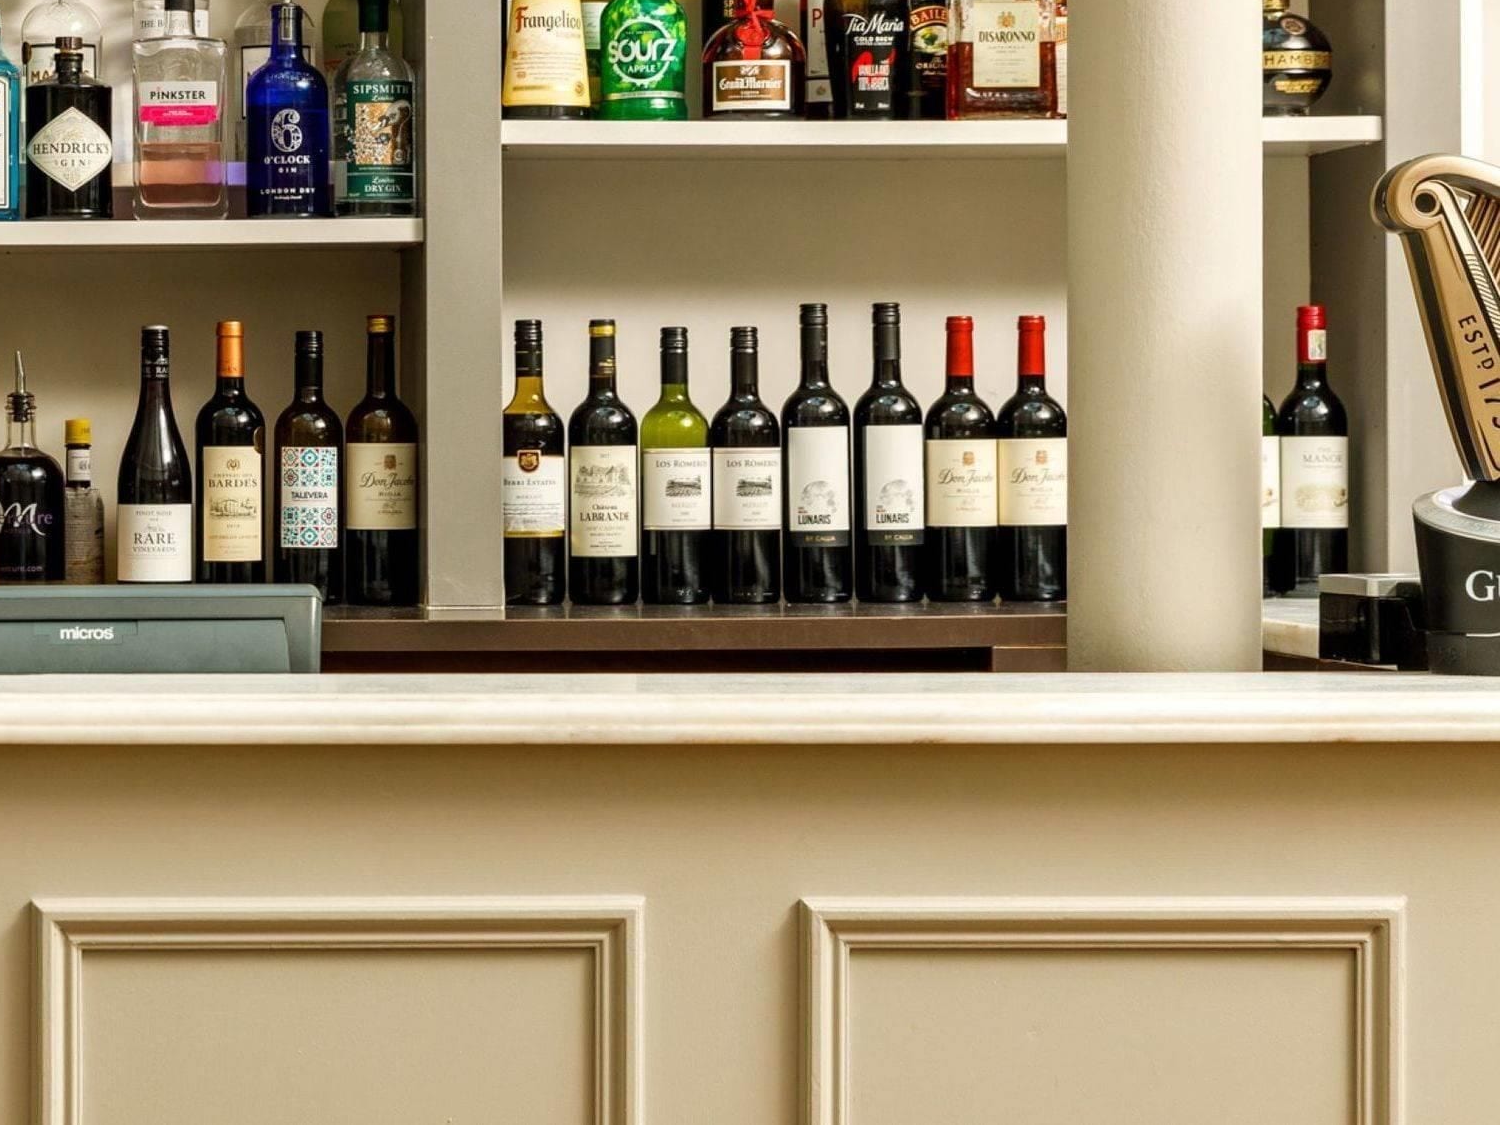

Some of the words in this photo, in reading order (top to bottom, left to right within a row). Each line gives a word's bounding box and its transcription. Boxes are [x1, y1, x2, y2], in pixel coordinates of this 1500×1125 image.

[515, 6, 582, 34] Frangelico
[911, 9, 947, 25] BAILE
[842, 13, 867, 35] Tia
[863, 13, 904, 35] Maria
[979, 31, 1036, 43] DISARONNO
[627, 65, 657, 74] APPLE
[150, 90, 206, 100] PINKSTER
[353, 84, 409, 95] SIPSMITH
[271, 108, 303, 153] 6
[264, 155, 311, 165] O'CLOCK
[260, 187, 296, 195] LONDON
[364, 184, 384, 194] DRY
[385, 184, 401, 193] GIN
[655, 459, 671, 468] LOS
[726, 459, 742, 468] LOS
[208, 478, 258, 488] BARDES
[359, 471, 386, 488] Don
[291, 491, 329, 500] TALEVERA
[580, 511, 630, 522] LABRANDE
[798, 514, 832, 525] LUNARIS
[876, 513, 910, 524] LUNARIS
[134, 532, 177, 545] RARE
[59, 626, 115, 641] micros
